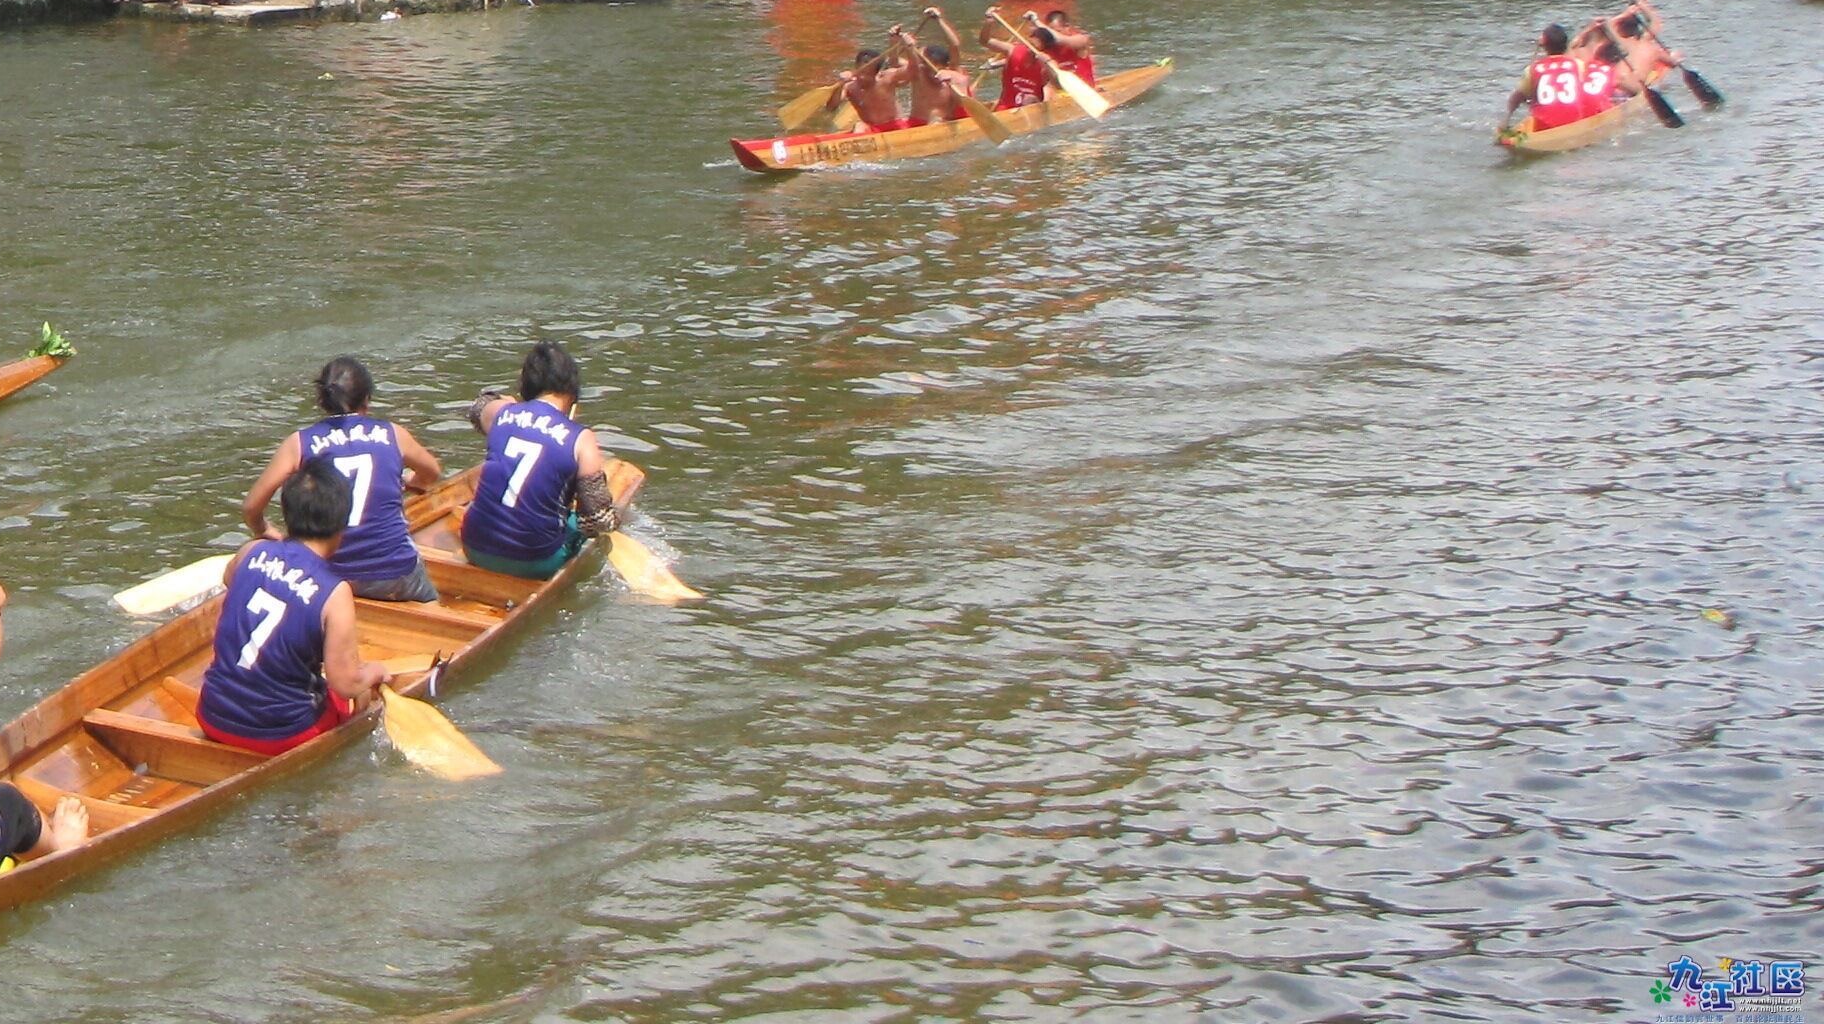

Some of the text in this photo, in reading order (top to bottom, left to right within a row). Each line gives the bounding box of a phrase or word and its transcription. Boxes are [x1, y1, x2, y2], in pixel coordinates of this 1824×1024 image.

[1537, 72, 1576, 105] 63
[333, 453, 374, 527] 7
[501, 435, 544, 509] 7
[236, 586, 288, 671] 7
